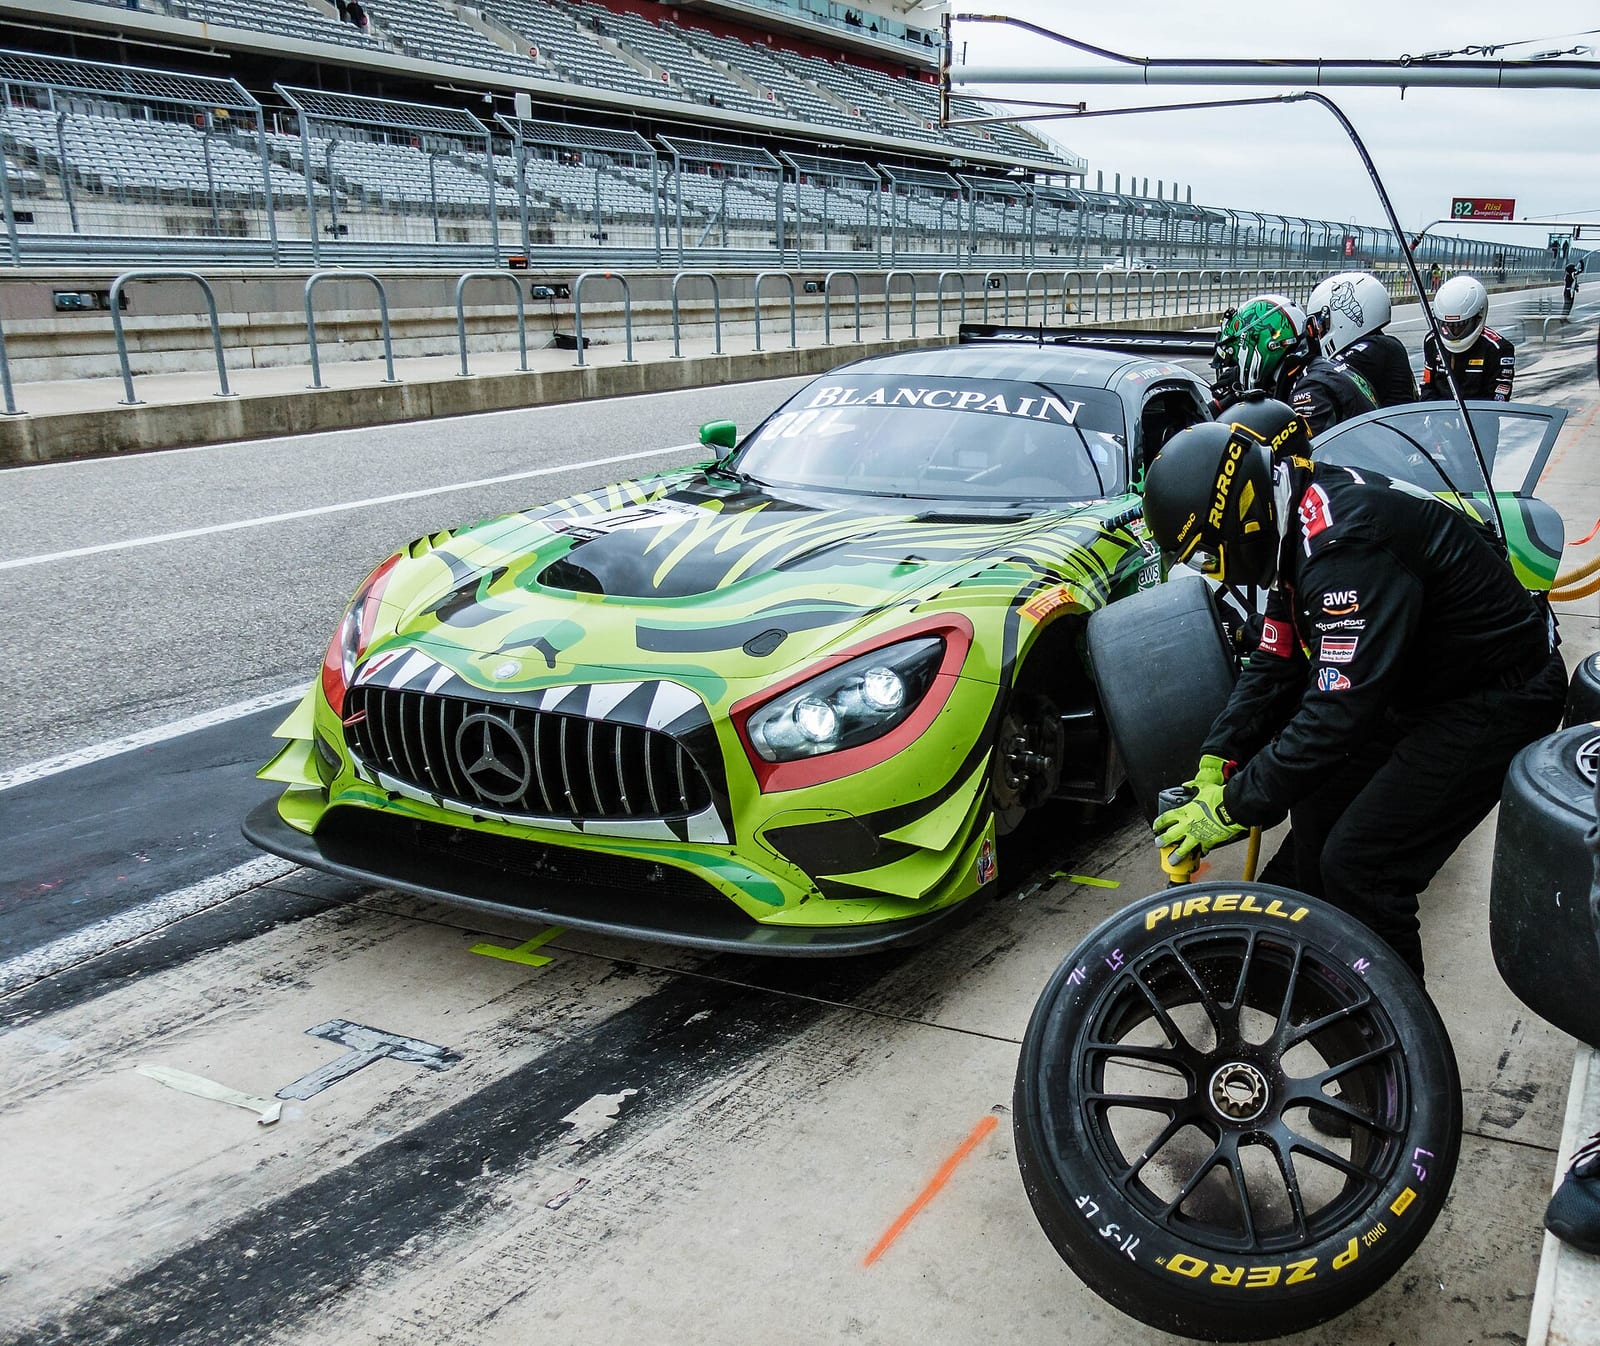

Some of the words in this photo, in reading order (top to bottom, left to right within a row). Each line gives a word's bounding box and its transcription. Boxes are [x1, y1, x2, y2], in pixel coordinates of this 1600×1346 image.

[1454, 202, 1472, 215] 82
[804, 386, 1086, 425] BLANCPAIN
[1293, 392, 1311, 402] aws
[1271, 420, 1298, 452] ROC
[1138, 563, 1160, 585] aws
[1323, 590, 1357, 606] aws
[1145, 894, 1309, 931] PIRELLI
[1105, 948, 1124, 971] LF
[1075, 1195, 1100, 1219] LF
[1332, 1236, 1359, 1271] P
[1166, 1253, 1318, 1288] ZERO
